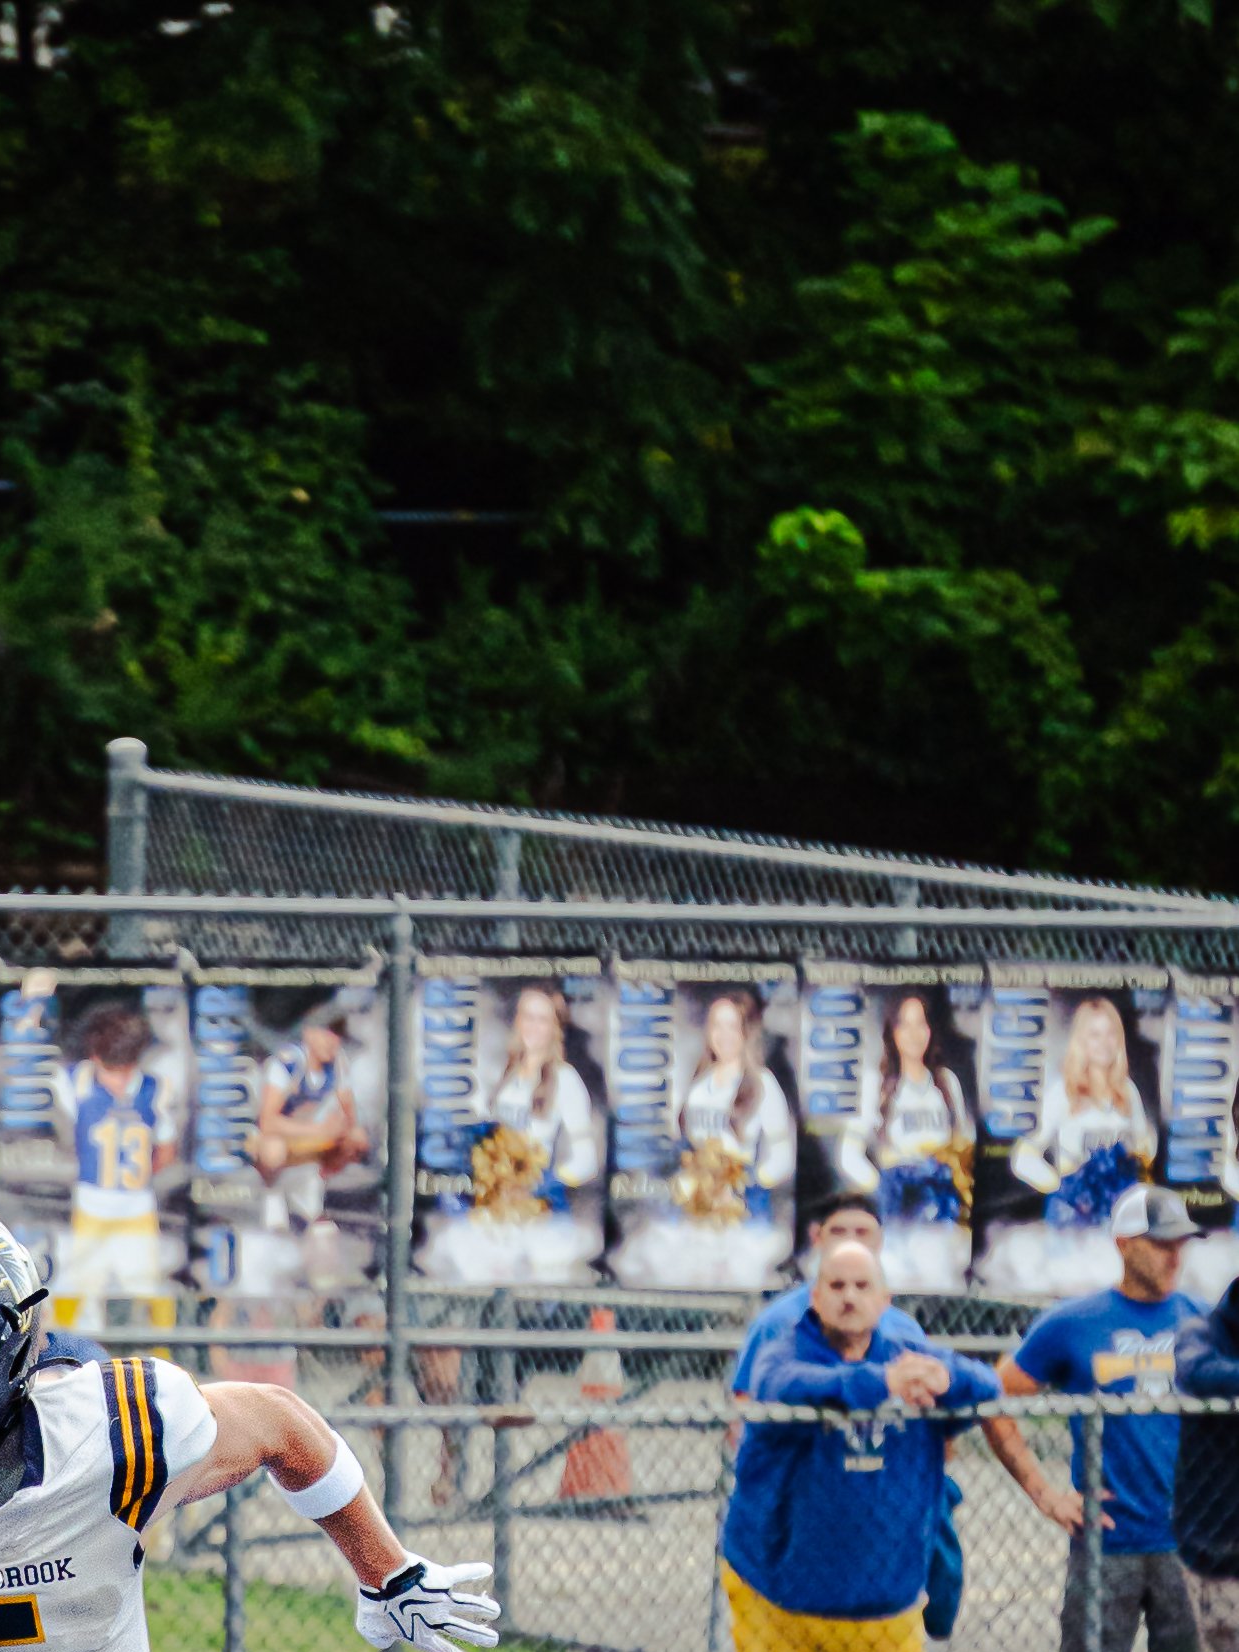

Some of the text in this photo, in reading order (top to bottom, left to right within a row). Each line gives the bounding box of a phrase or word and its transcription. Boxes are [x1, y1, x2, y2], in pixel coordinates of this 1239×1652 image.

[0, 989, 59, 1128] JONES
[195, 986, 256, 1172] CROKER
[421, 979, 479, 1168] CROKER
[615, 984, 673, 1169] MALONE
[808, 987, 864, 1114] RAGO
[984, 988, 1048, 1138] GANGI
[1167, 999, 1232, 1182] MATUTE
[90, 1118, 153, 1190] 13
